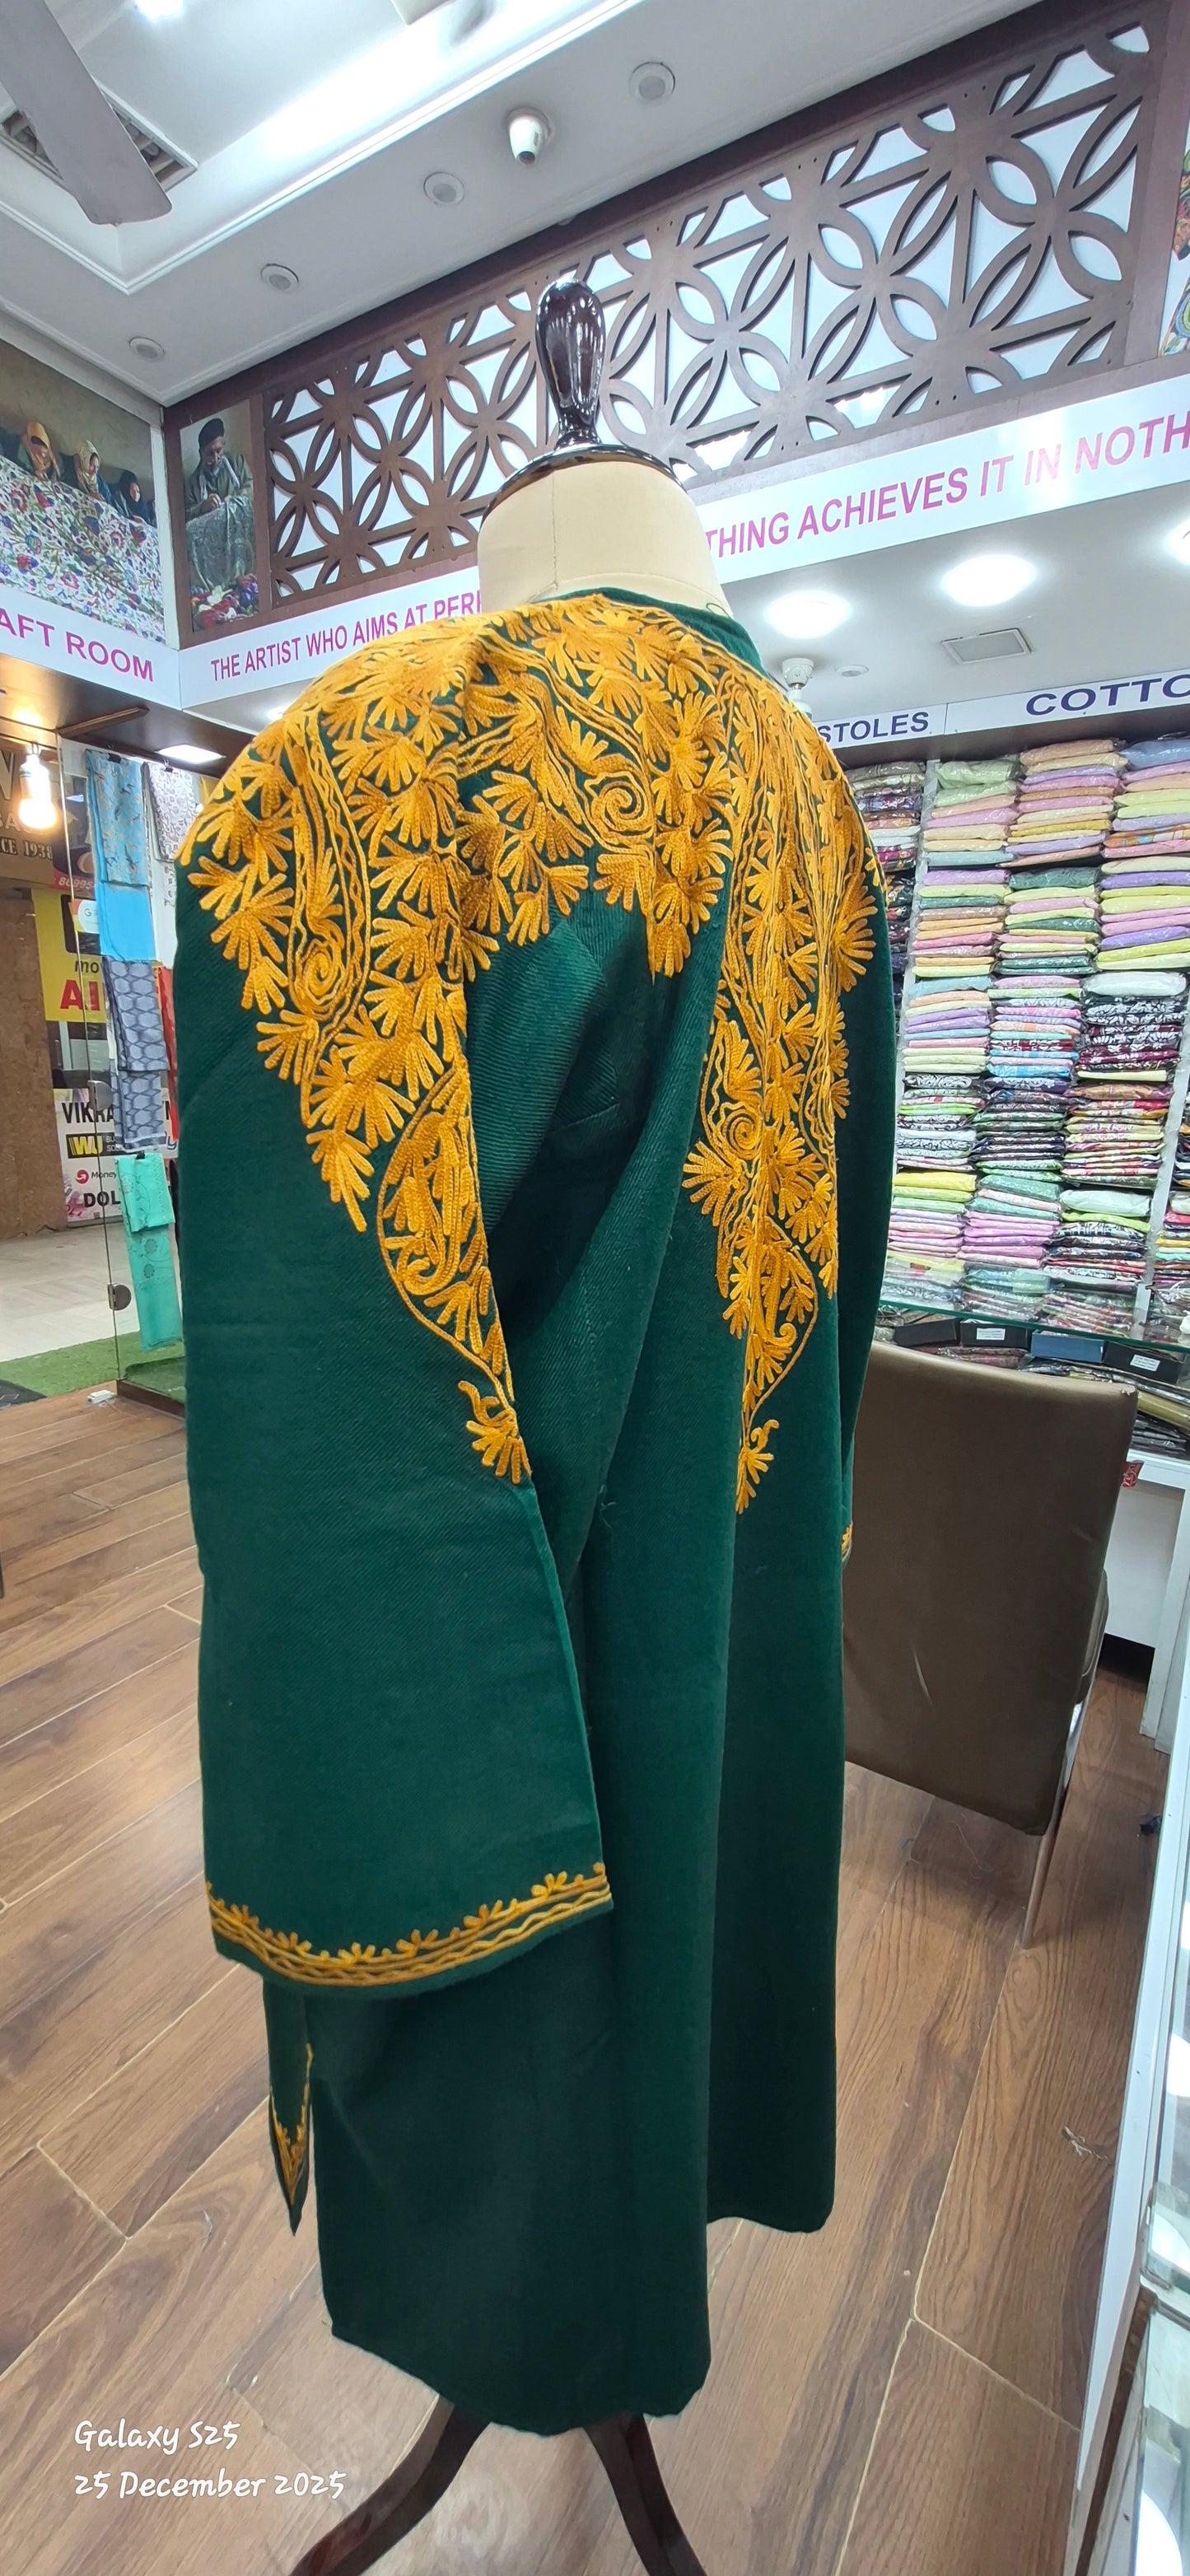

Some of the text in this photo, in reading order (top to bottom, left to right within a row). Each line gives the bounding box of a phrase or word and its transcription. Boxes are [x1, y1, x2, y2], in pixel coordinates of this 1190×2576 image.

[211, 654, 240, 681] THE
[245, 637, 301, 674] ARTIST
[306, 625, 348, 657] WHO
[352, 612, 399, 646] AIMS
[404, 604, 427, 629] AT
[797, 467, 968, 539] ACHIEVES
[979, 455, 1015, 497] IT
[1024, 444, 1062, 486] IN
[1075, 410, 1190, 474] NOTH
[0, 607, 154, 683] AFT ROOM
[1026, 674, 1190, 716] COTTO
[817, 712, 929, 744] STOLES
[24, 840, 54, 860] 1938
[83, 1190, 121, 1208] DOL
